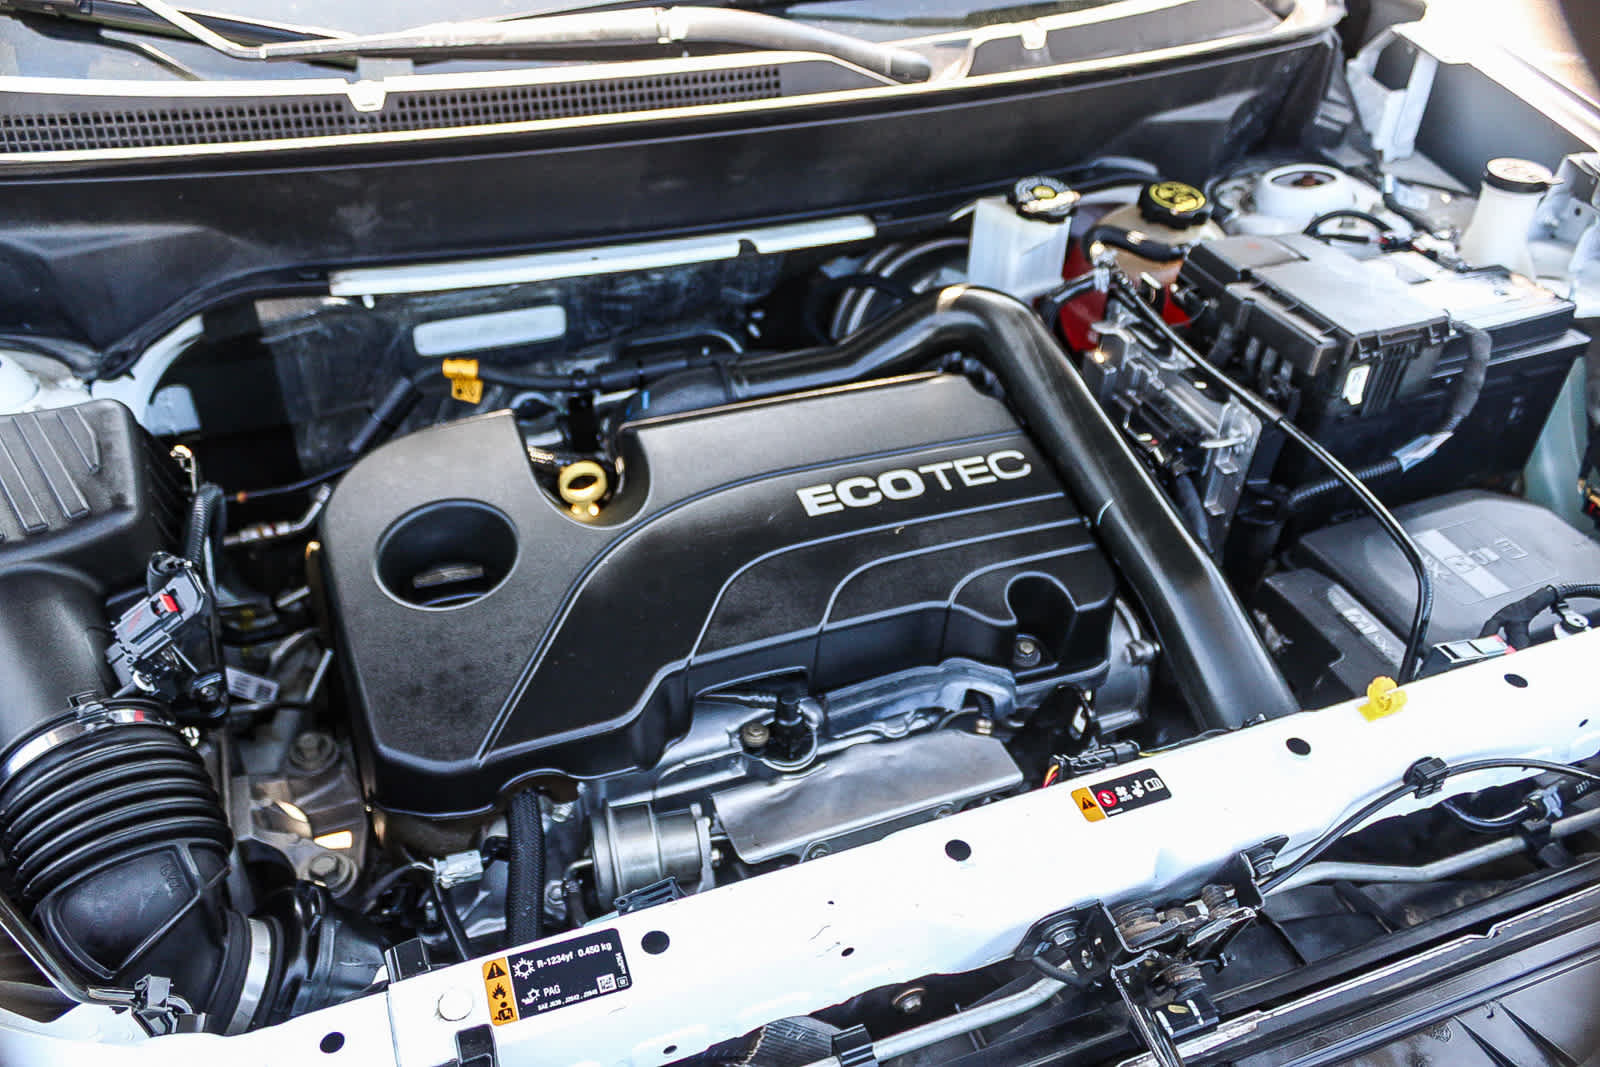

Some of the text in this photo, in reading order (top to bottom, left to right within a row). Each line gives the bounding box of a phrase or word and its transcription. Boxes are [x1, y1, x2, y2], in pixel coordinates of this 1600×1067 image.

[795, 449, 1032, 518] ECOTEC
[536, 942, 612, 969] R-1234yf 0.450 kg
[543, 984, 561, 997] PAG
